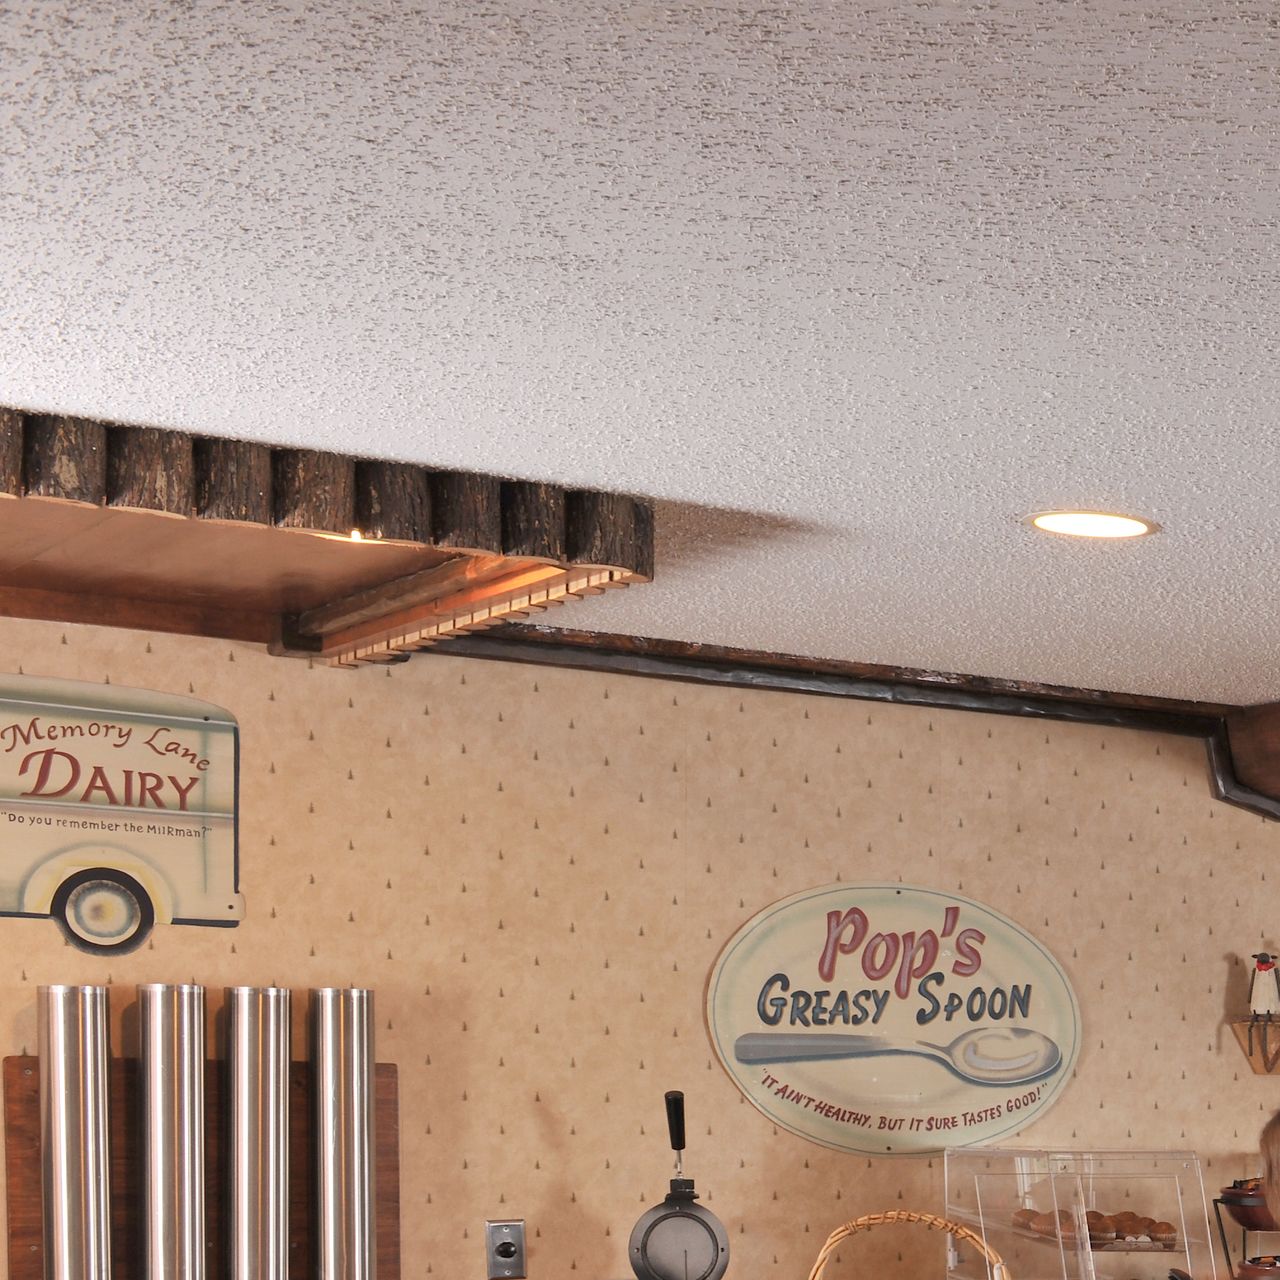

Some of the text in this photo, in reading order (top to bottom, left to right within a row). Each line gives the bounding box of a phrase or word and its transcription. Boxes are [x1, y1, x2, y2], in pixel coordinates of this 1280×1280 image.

[1, 717, 211, 771] Memory Lane
[18, 748, 200, 811] DAIRY
[29, 816, 52, 826] you
[57, 819, 120, 832] remember
[124, 822, 143, 833] the
[818, 906, 985, 999] Pop's
[756, 972, 1031, 1027] GREASY SPOON
[774, 1084, 815, 1109] AIN'T
[814, 1101, 872, 1129] HEALTHY,
[878, 1116, 905, 1131] BUT
[909, 1117, 924, 1132] IT
[925, 1116, 958, 1132] SURE
[961, 1105, 1002, 1127] TASTES
